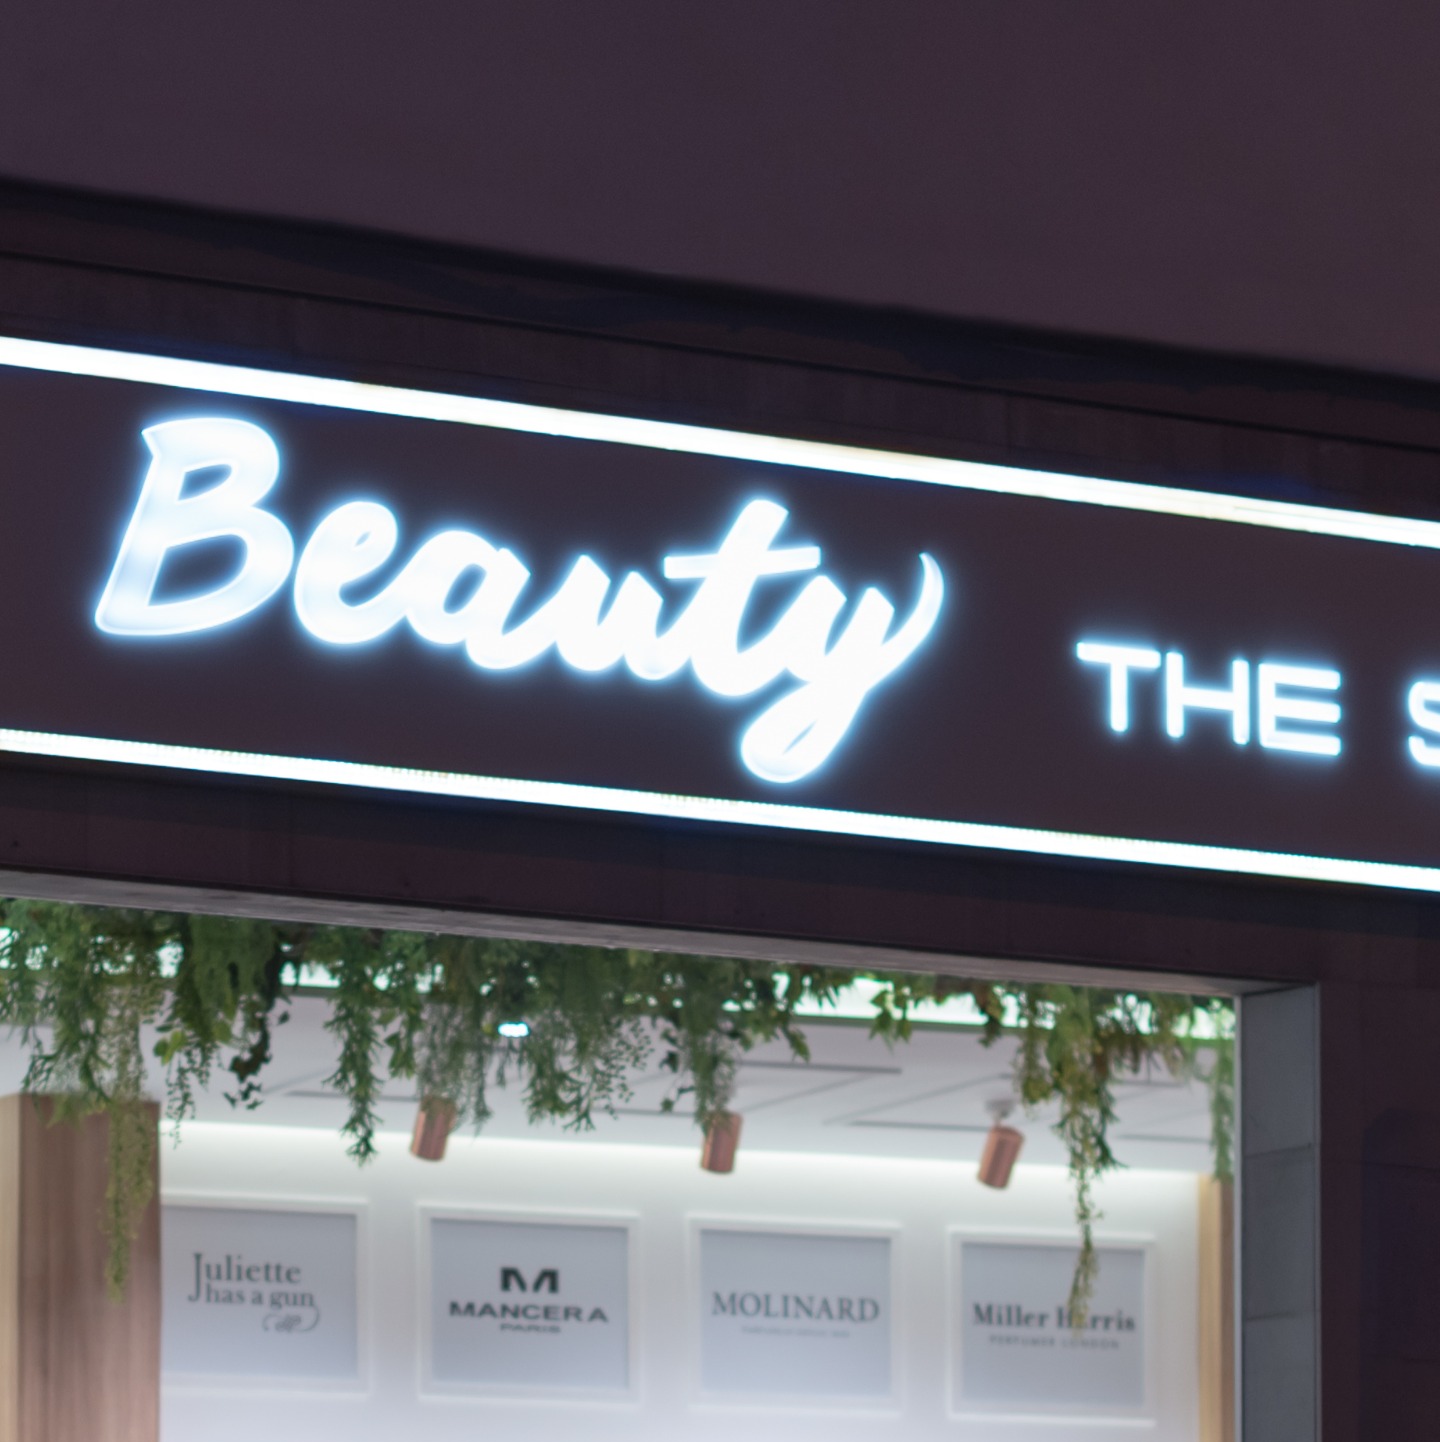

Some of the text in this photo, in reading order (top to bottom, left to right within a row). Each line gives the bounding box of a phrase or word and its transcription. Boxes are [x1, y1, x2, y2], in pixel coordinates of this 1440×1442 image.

[93, 416, 942, 783] Beauty
[1076, 640, 1341, 757] THE
[188, 1252, 302, 1303] Juliette
[205, 1283, 315, 1311] has a gun
[449, 1300, 609, 1323] MANCERA
[711, 1291, 880, 1323] MOLINARD
[973, 1302, 1049, 1327] Miller
